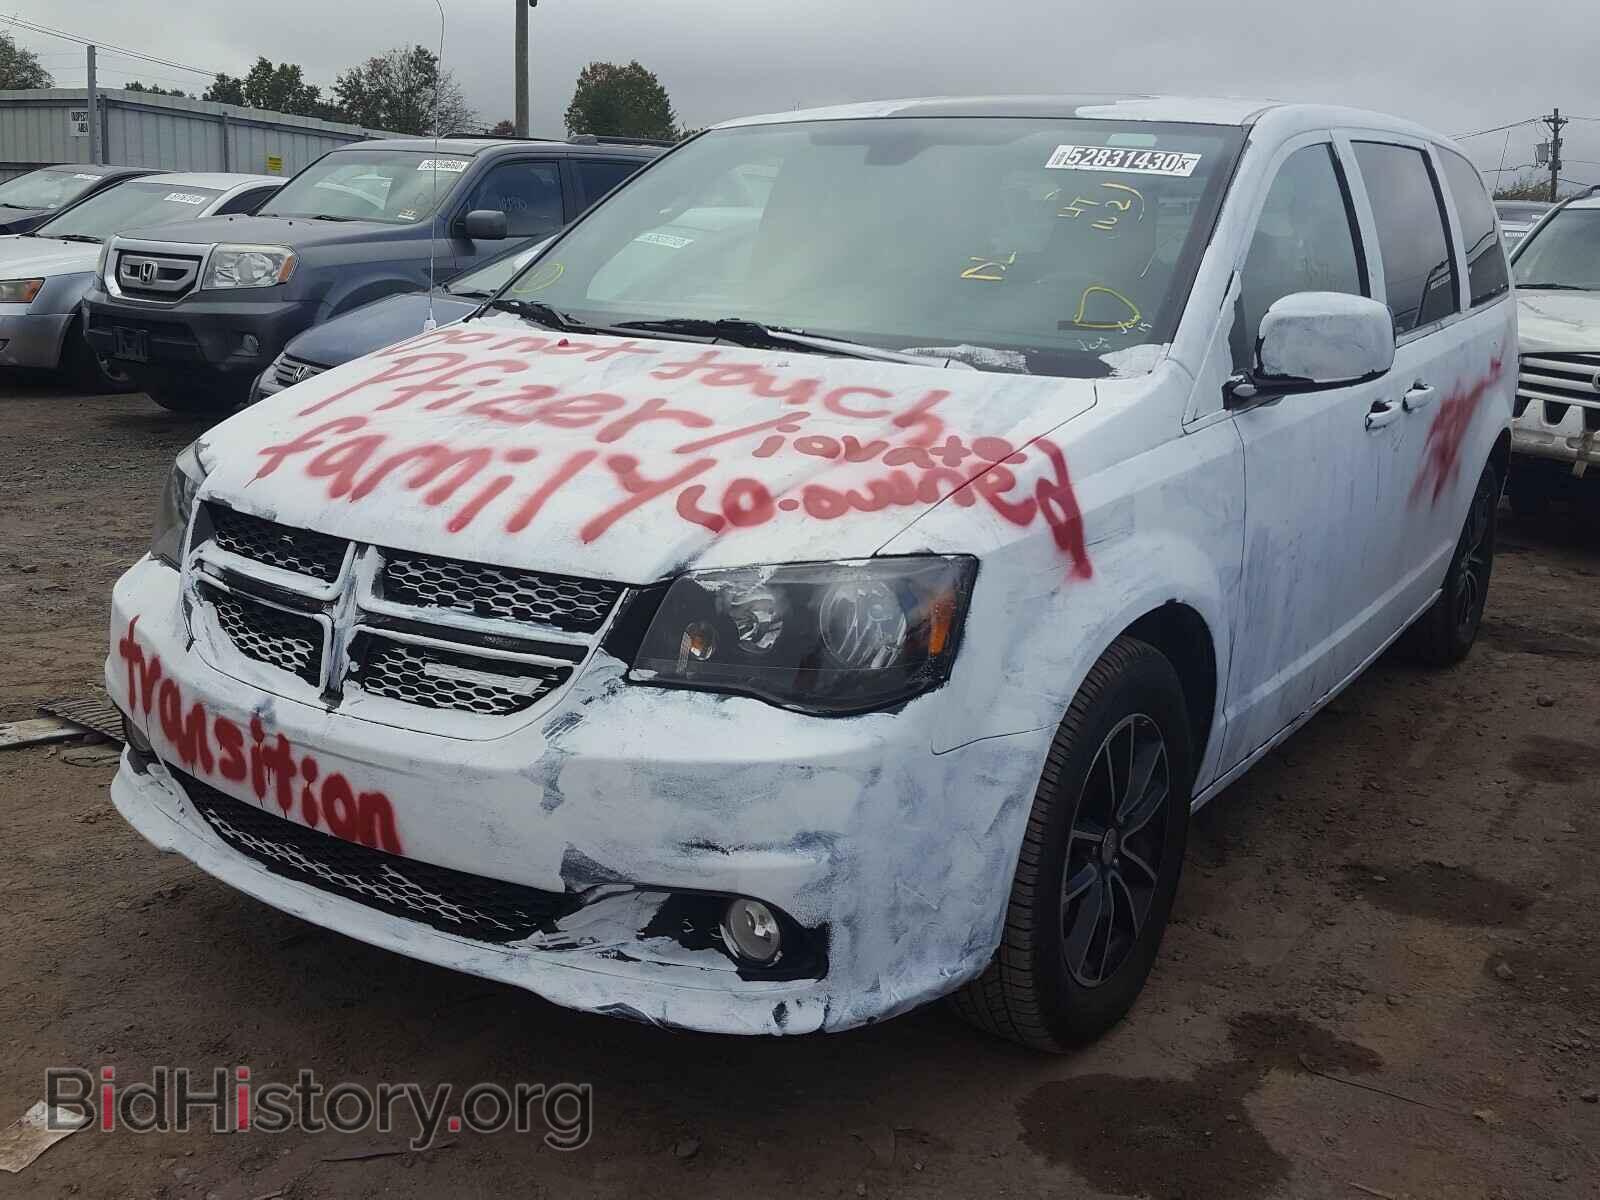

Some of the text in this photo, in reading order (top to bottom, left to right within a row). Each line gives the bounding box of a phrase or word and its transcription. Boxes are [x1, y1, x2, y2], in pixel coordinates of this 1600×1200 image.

[1066, 147, 1182, 171] 52831430
[488, 335, 661, 362] not
[650, 350, 952, 447] touch
[244, 415, 717, 545] family
[119, 615, 404, 857] transition
